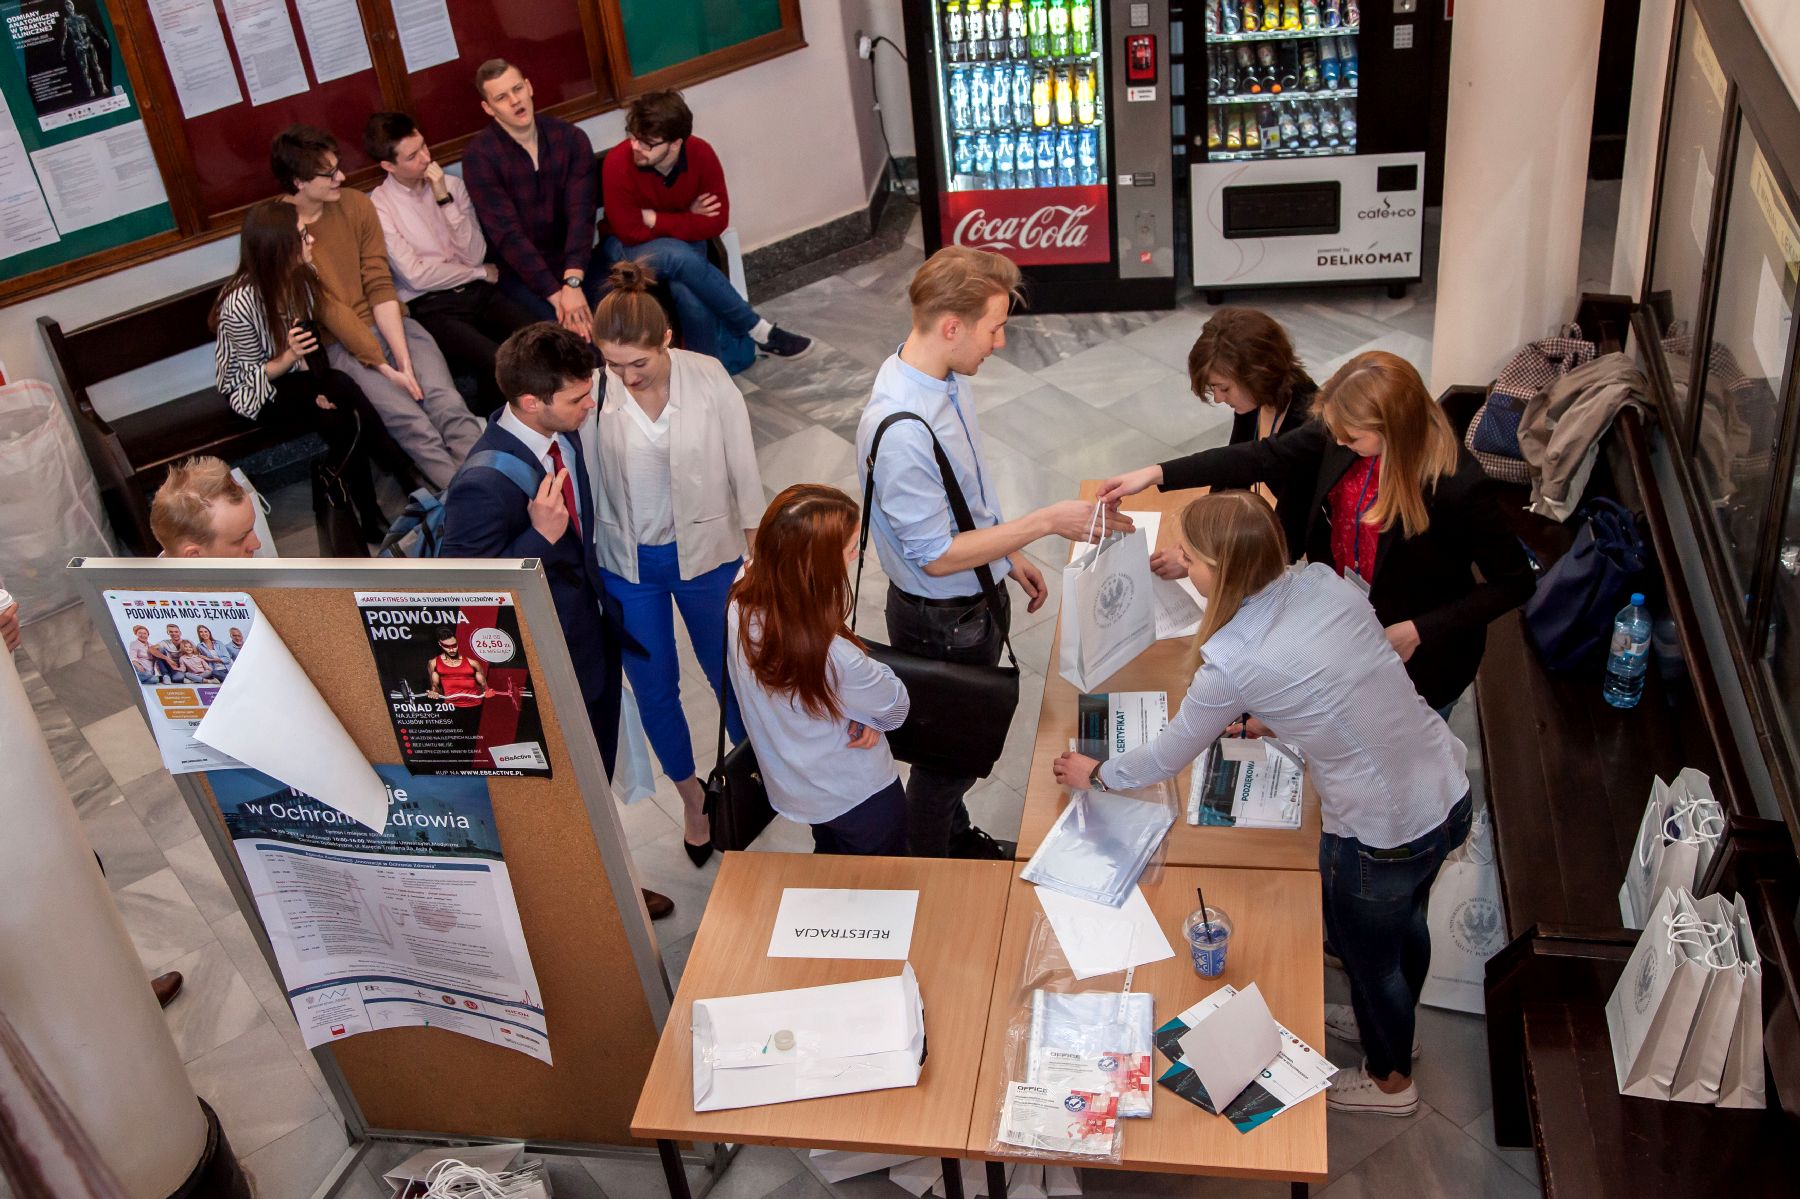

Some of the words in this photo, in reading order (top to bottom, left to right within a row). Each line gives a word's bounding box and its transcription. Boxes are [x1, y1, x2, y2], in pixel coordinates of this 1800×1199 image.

[6, 11, 39, 23] ODMIANY
[9, 11, 60, 29] ANATOMICZNE
[19, 19, 56, 31] PRAKTYCE
[12, 25, 53, 39] KLINICZNEJ
[953, 205, 1096, 250] Coca-Cola
[125, 607, 178, 619] PODWÓJNA
[179, 608, 201, 619] MOC
[201, 607, 250, 620] JĘZYKÓW!
[365, 607, 470, 624] PODWÓJNA
[370, 627, 412, 640] MOC
[393, 703, 433, 712] PONAD
[435, 703, 456, 712] 200
[1116, 710, 1125, 754] CERTYFIKAT
[1241, 760, 1255, 801] PODZIĘKOWA
[243, 802, 263, 815] w
[269, 803, 357, 824] Ochron
[386, 809, 470, 829] drowia
[794, 928, 890, 939] REJESTRACJA
[1050, 1051, 1081, 1060] OFFICE
[1017, 1085, 1048, 1093] OFFICE
